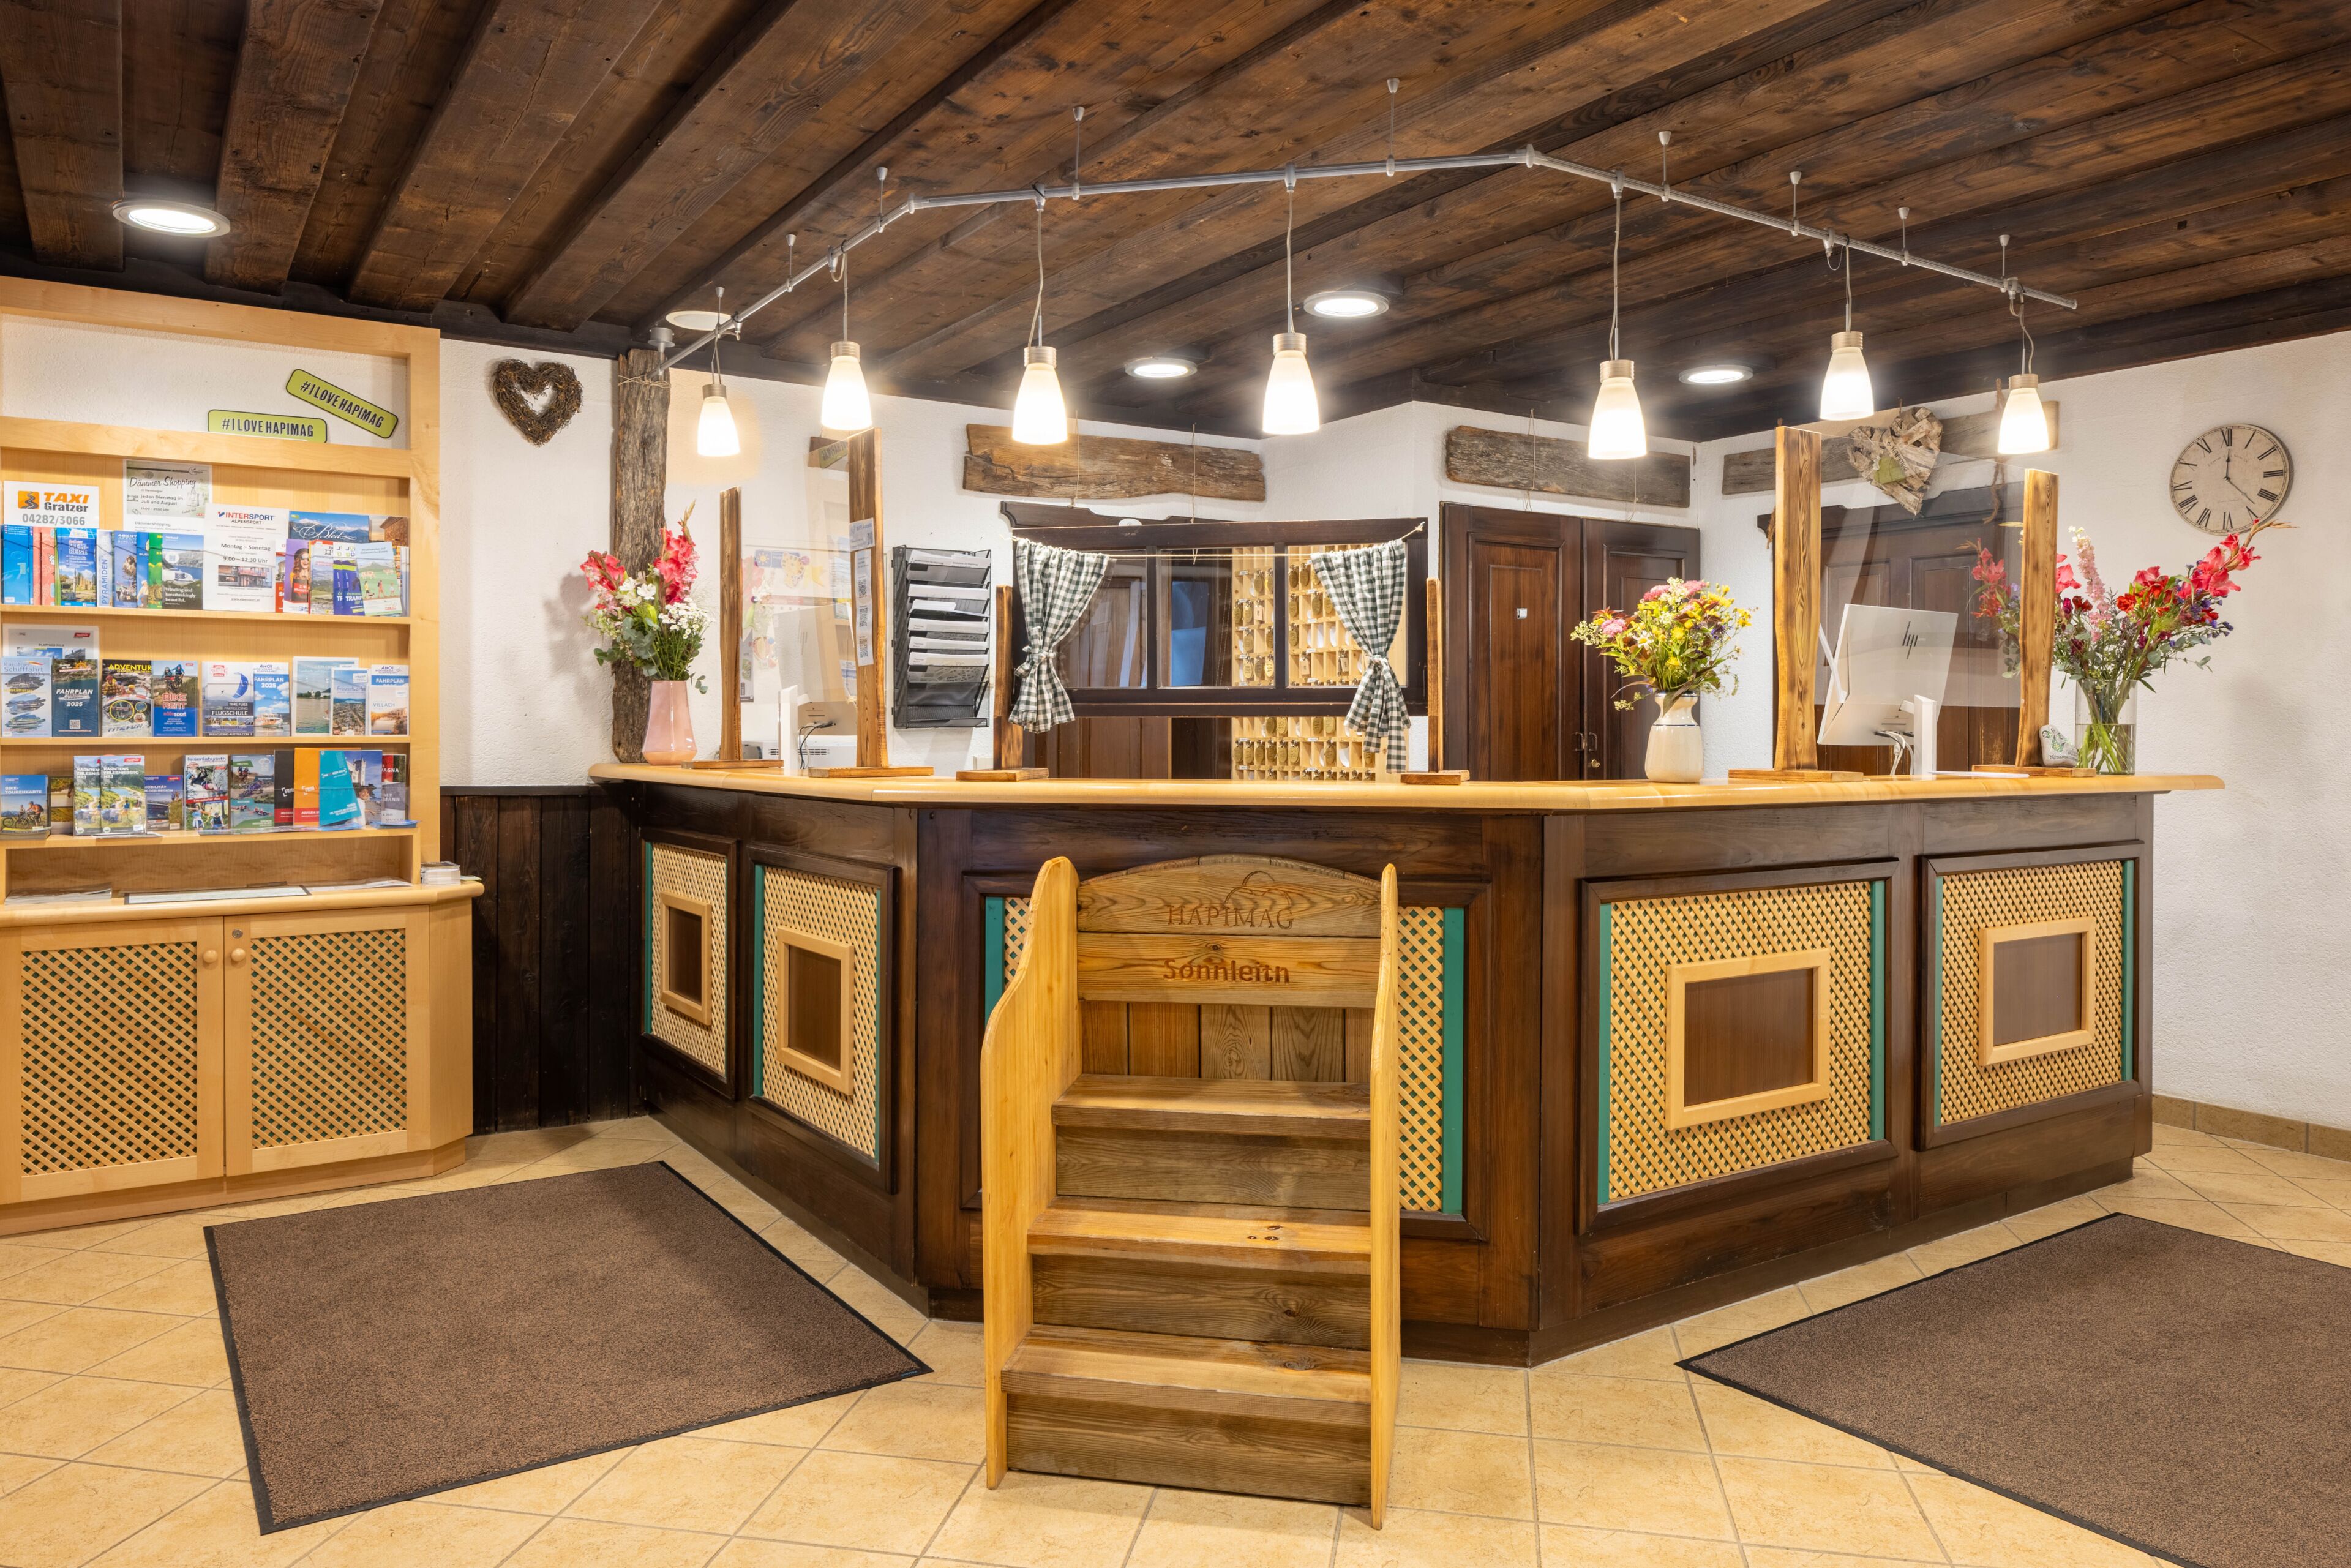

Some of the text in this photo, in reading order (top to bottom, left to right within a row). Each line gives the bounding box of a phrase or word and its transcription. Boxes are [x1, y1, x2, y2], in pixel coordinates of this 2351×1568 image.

[314, 386, 340, 407] LOVE
[338, 399, 384, 428] HAPIMAG
[238, 419, 263, 433] LOVE
[266, 421, 314, 437] HAPIMAG
[129, 476, 197, 489] Dämmer Shopping
[44, 492, 89, 504] TAXI
[44, 501, 89, 512] Gratzer
[22, 513, 86, 526] 04282/3066
[225, 512, 274, 521] INTERSPORT
[162, 693, 187, 702] BIKE
[1166, 904, 1295, 929] HAPIMAG
[1163, 958, 1290, 984] Sonnleitn
